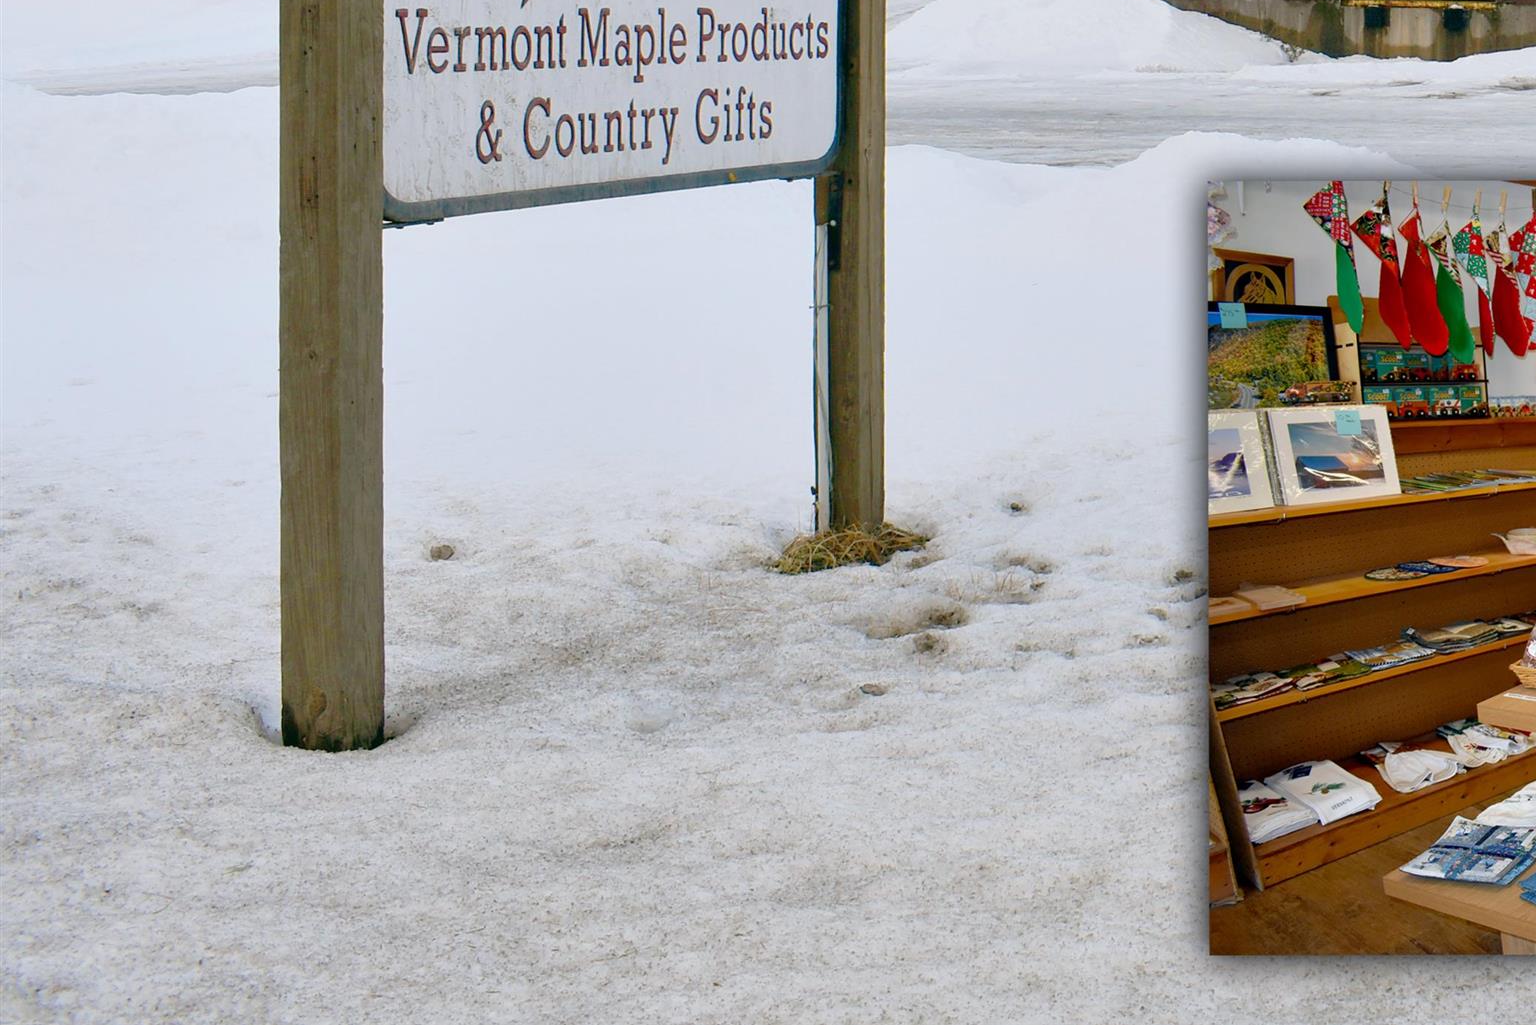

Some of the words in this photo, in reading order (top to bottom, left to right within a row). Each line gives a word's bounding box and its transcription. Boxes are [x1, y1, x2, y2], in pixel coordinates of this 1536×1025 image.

[395, 8, 568, 76] Vermont
[577, 6, 688, 84] Maple
[695, 7, 830, 63] Products
[475, 99, 503, 166] &
[522, 97, 680, 166] Country
[695, 86, 774, 146] Gifts
